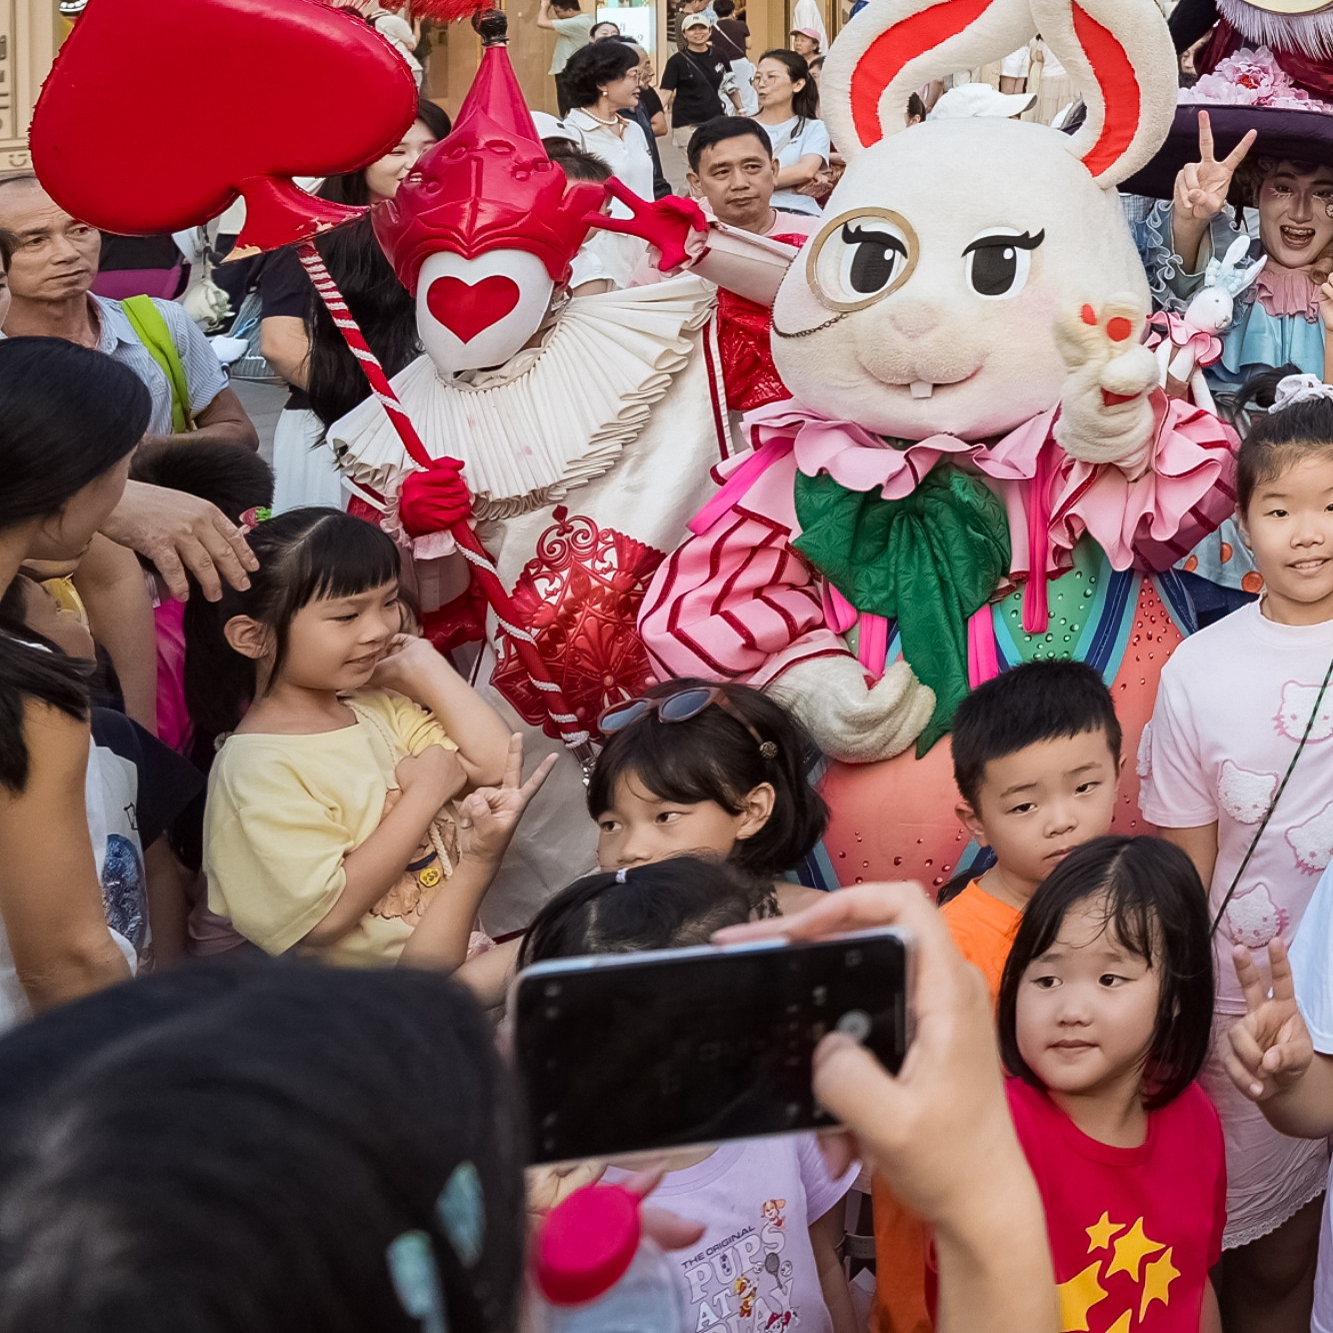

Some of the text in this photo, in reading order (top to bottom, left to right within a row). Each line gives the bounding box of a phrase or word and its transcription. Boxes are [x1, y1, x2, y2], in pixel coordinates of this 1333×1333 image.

[681, 1225, 757, 1270] THE ORIGINAL
[684, 1220, 786, 1306] PUPS
[695, 1286, 734, 1333] AT
